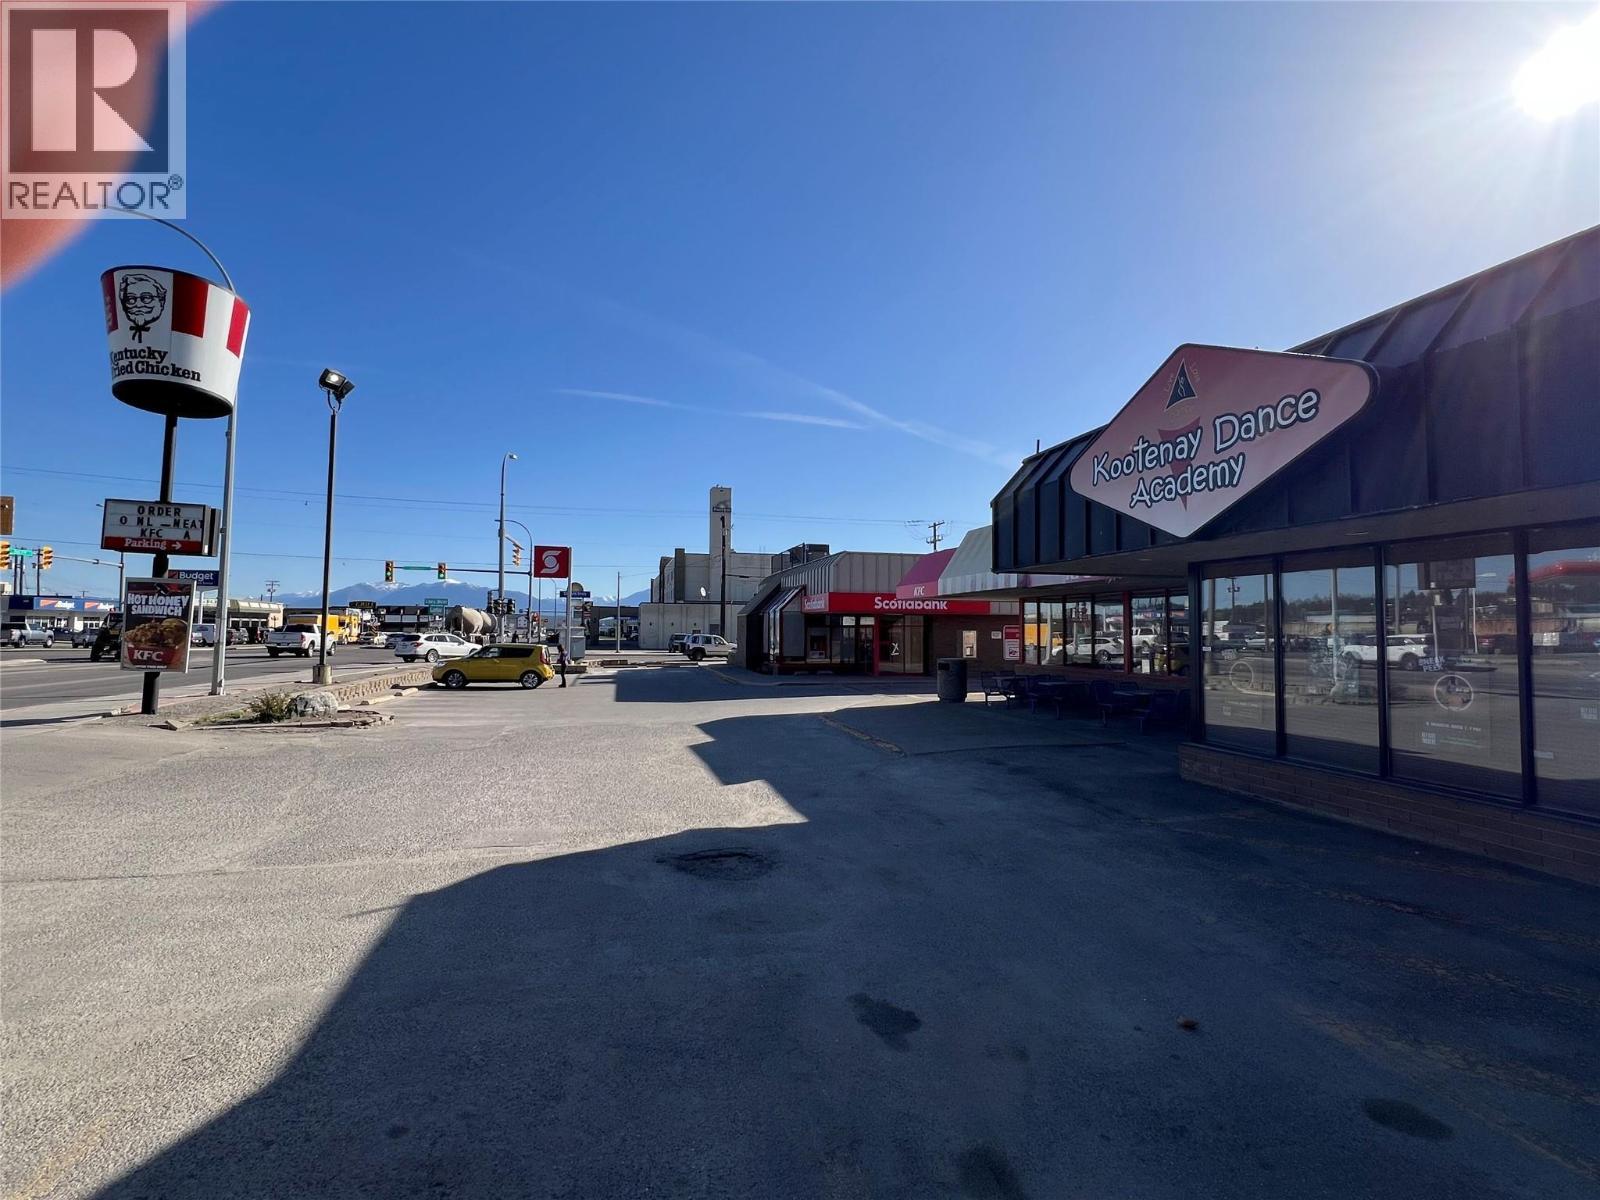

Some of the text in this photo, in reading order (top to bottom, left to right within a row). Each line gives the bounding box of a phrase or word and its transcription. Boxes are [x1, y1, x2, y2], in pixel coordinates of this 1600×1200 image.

[135, 360, 201, 382] Chicken
[1092, 388, 1320, 486] Kootenay Dance
[1129, 453, 1246, 509] Academy
[137, 506, 181, 517] ORDER
[140, 528, 163, 538] KFC
[124, 538, 168, 551] Parking
[179, 571, 214, 582] Budget
[127, 593, 190, 609] HOT HONEY
[131, 605, 183, 617] SANDWICH
[133, 649, 164, 662] KFC
